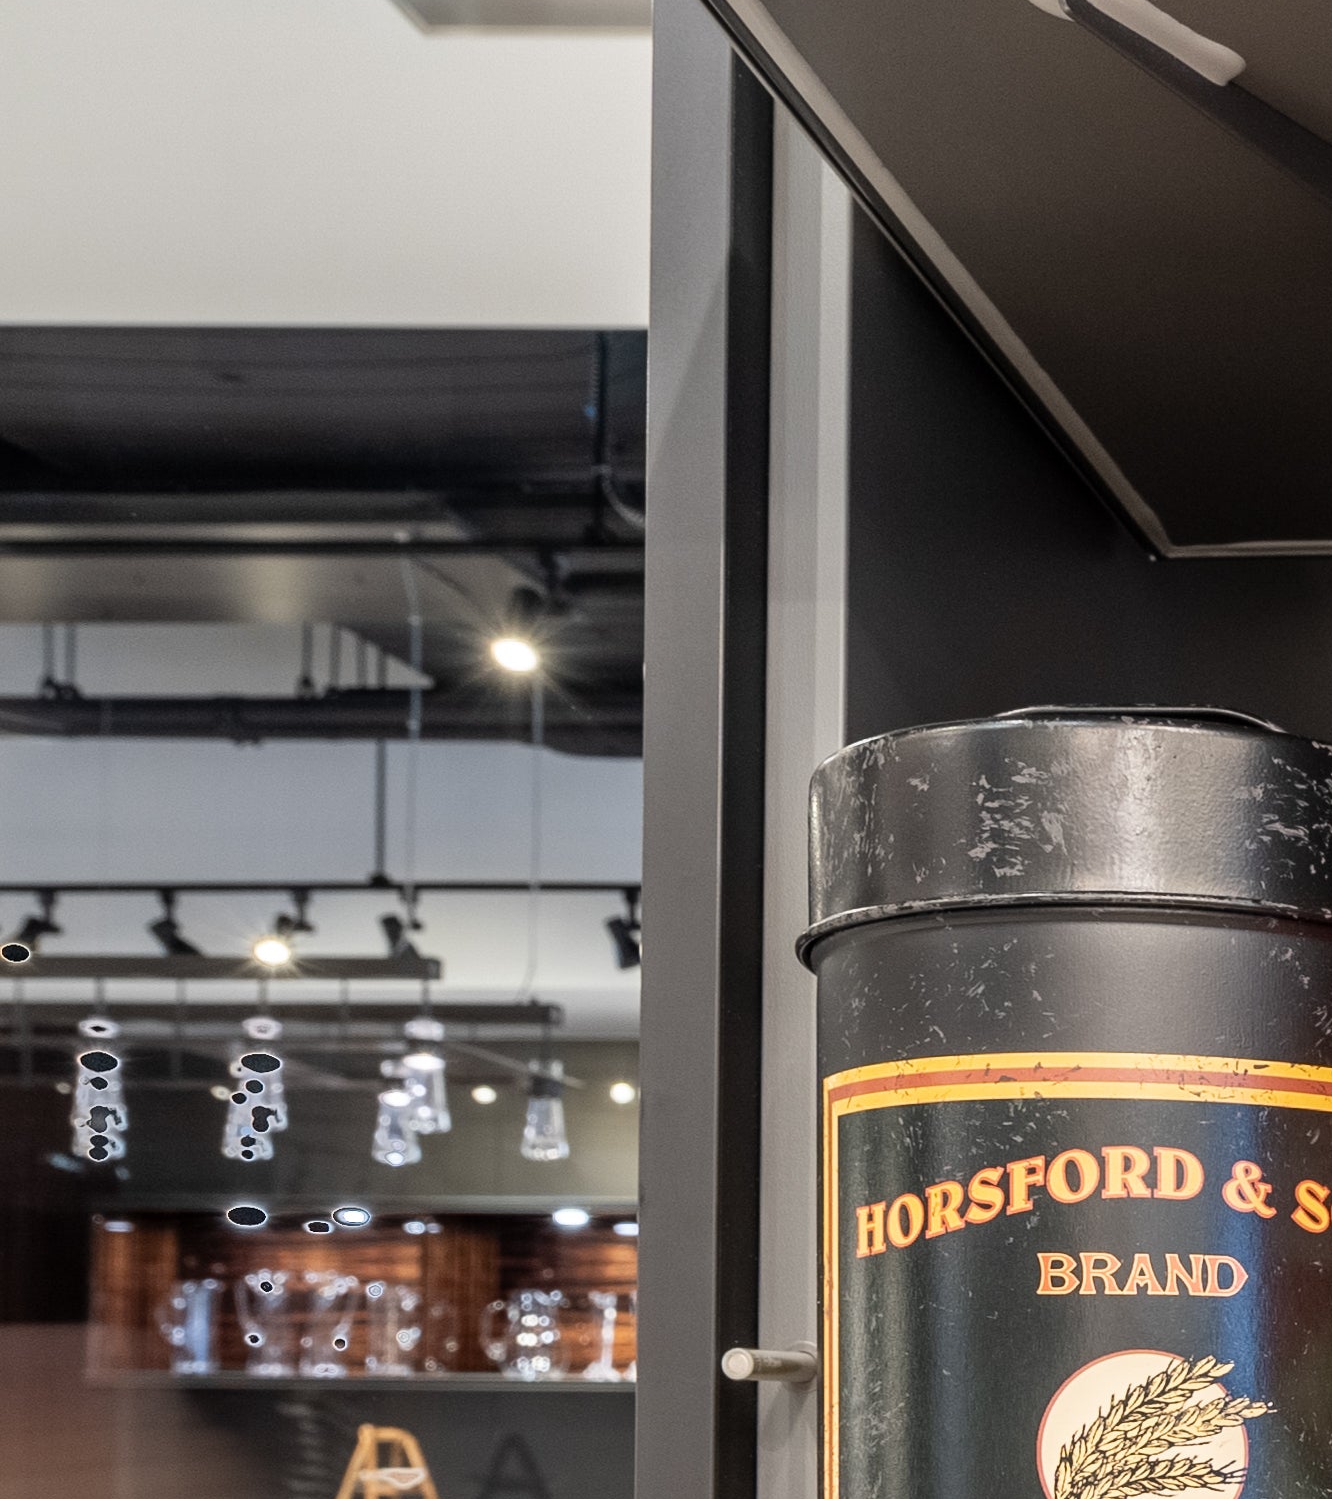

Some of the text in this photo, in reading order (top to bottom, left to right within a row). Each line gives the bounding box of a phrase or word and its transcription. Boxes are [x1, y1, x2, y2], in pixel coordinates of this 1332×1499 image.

[854, 1145, 1205, 1259] HORSFORD
[1222, 1159, 1278, 1220] &
[1036, 1252, 1249, 1296] BRAND
